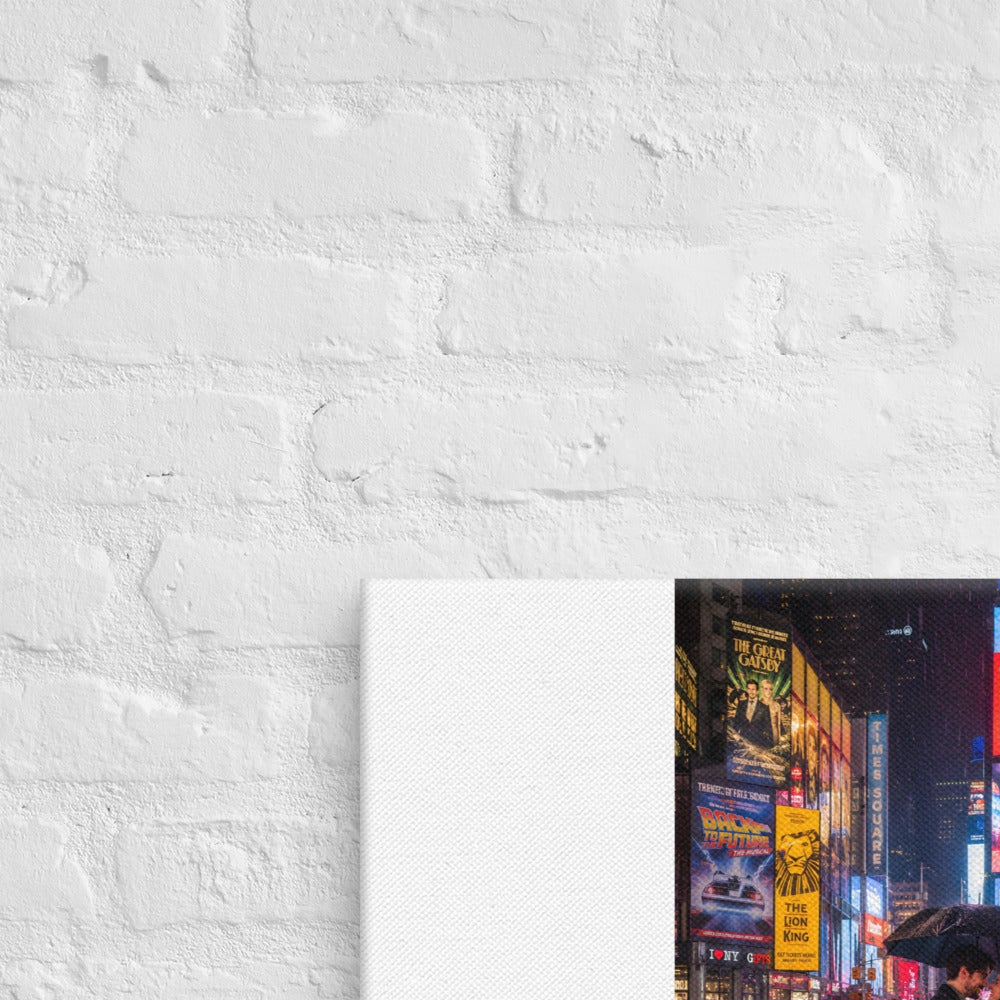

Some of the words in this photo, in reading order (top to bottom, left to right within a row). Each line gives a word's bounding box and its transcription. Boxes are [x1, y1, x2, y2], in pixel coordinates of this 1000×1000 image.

[733, 638, 751, 654] THE
[752, 643, 786, 662] GREAT
[738, 652, 781, 673] GATSBY
[871, 721, 883, 781] TIMES
[697, 806, 761, 834] BACK
[717, 832, 769, 849] FUTURE
[785, 902, 807, 913] THE
[783, 930, 809, 942] KING
[709, 949, 714, 960] I
[723, 950, 739, 962] NY
